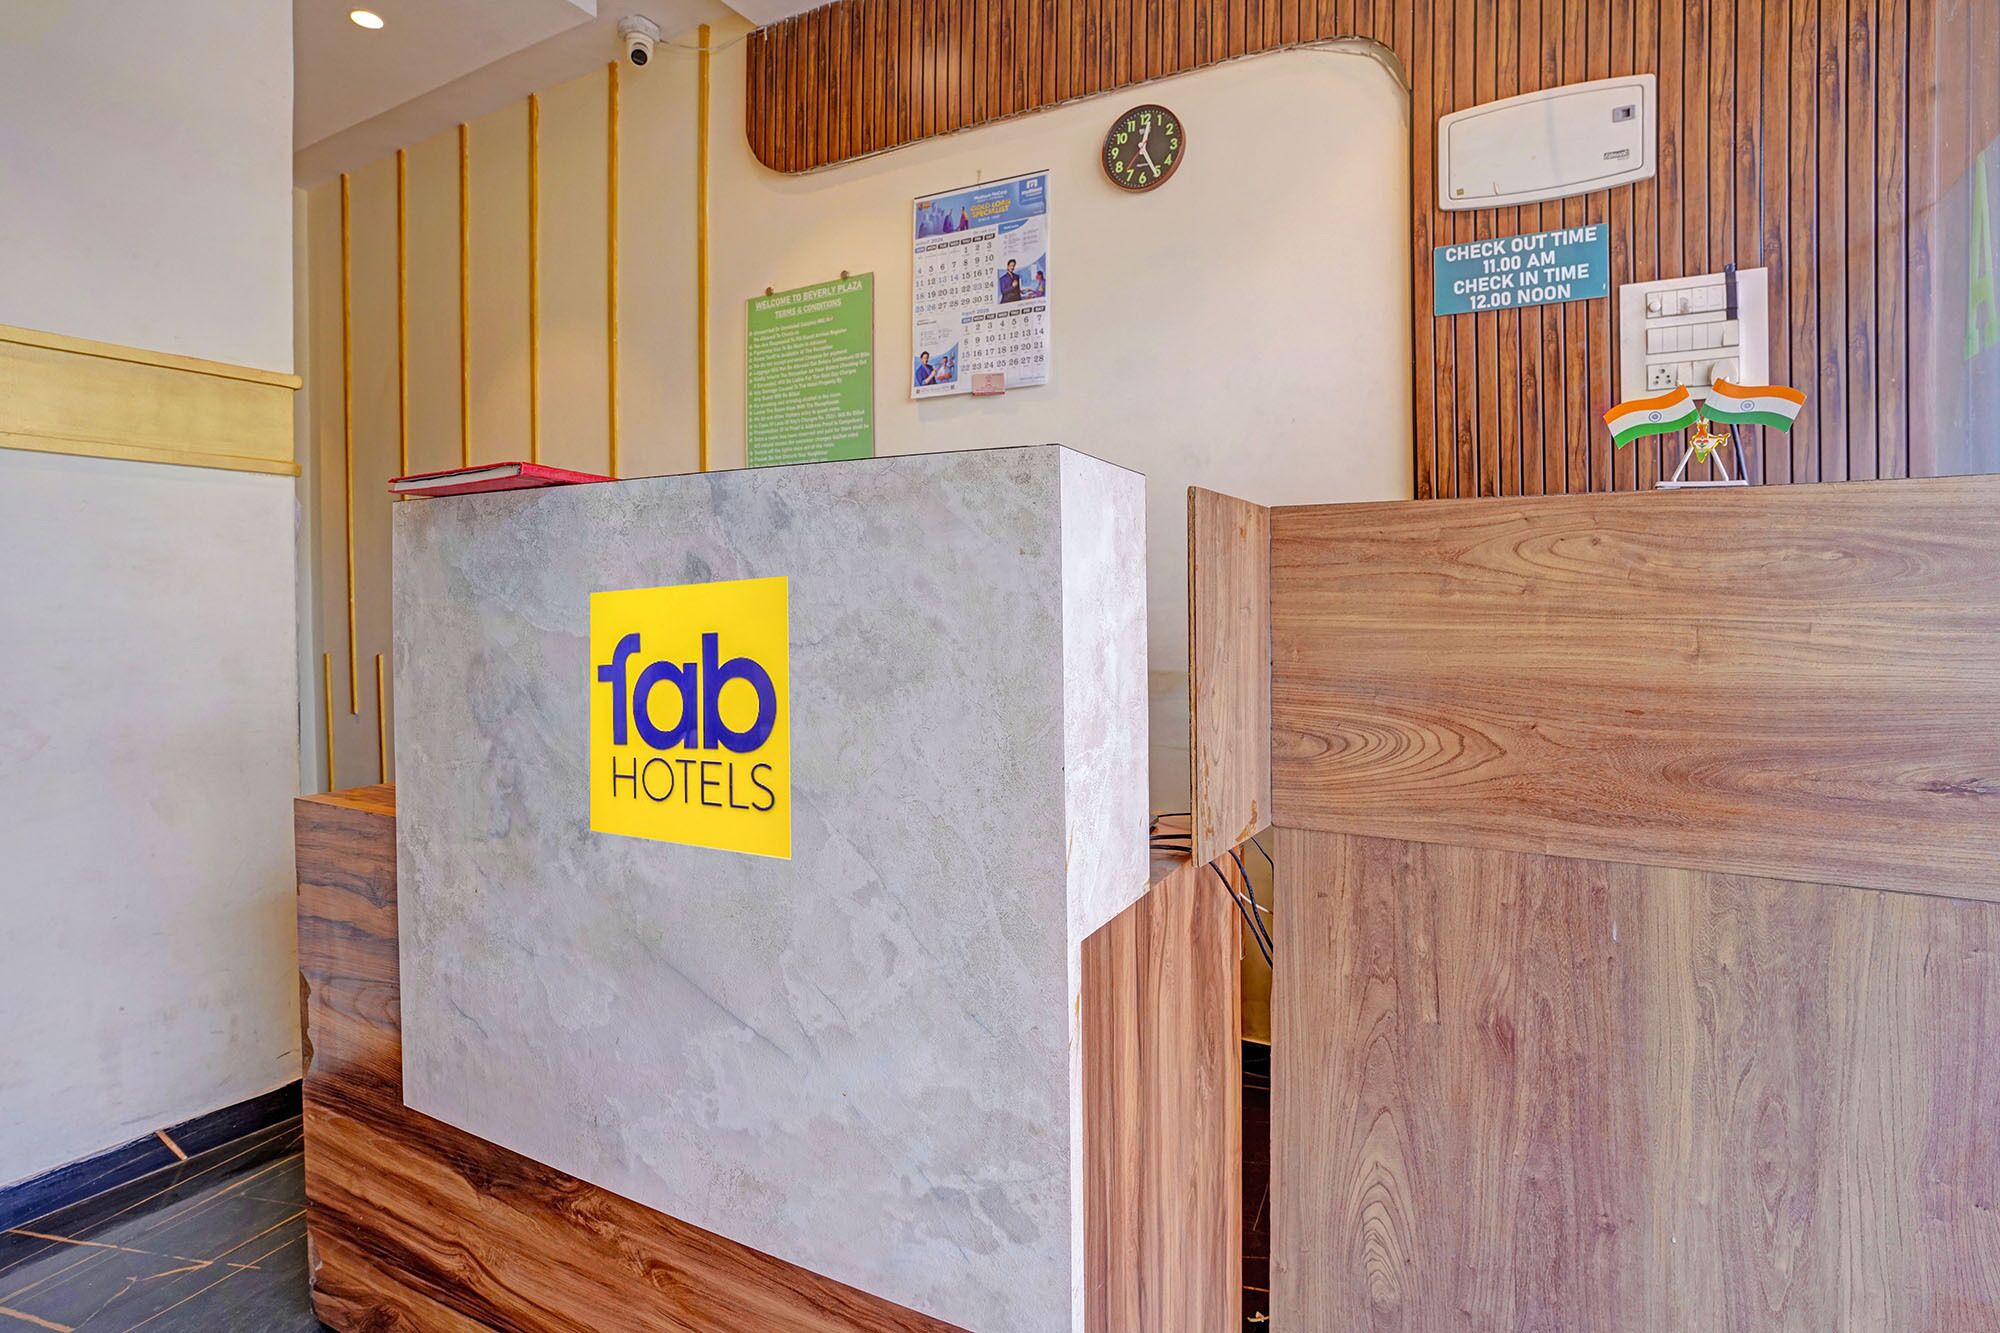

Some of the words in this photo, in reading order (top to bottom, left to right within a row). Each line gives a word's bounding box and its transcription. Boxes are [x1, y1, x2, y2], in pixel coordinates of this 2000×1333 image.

[1140, 113, 1151, 125] 12
[1157, 114, 1162, 126] 1
[1127, 120, 1136, 132] 11
[1166, 123, 1174, 135] 2
[1116, 133, 1128, 144] 10
[1169, 138, 1178, 150] 3
[1111, 147, 1119, 159] 9
[1164, 153, 1172, 165] 4
[1115, 161, 1123, 173] 8
[1154, 165, 1161, 177] 5
[1127, 169, 1134, 181] 7
[1139, 172, 1146, 184] 6
[1445, 240, 1506, 262] CHECK
[1511, 234, 1547, 251] OUT
[1551, 227, 1597, 247] TIME
[985, 254, 994, 262] 10
[1483, 256, 1521, 274] 11.00
[1527, 251, 1555, 268] AM
[962, 272, 970, 280] 15
[1453, 274, 1514, 295] CHECK
[1520, 271, 1538, 286] IN
[1544, 264, 1589, 283] TIME
[756, 296, 791, 311] WELCOME
[792, 294, 802, 303] TO
[803, 286, 837, 300] BEVERLY
[837, 280, 863, 292] PLAZA
[1470, 293, 1511, 310] 12.00
[1518, 284, 1570, 304] NOON
[775, 308, 796, 319] TERMS
[803, 298, 842, 313] CONDITIONS
[916, 305, 924, 313] 25
[1010, 331, 1019, 339] 12
[1022, 329, 1031, 337] 13
[998, 346, 1006, 354] 18
[1034, 341, 1043, 349] 21
[961, 364, 970, 372] 22
[1009, 358, 1019, 366] 26
[1021, 356, 1031, 364] 27
[598, 632, 777, 754] fab
[613, 756, 775, 811] HOTELS
